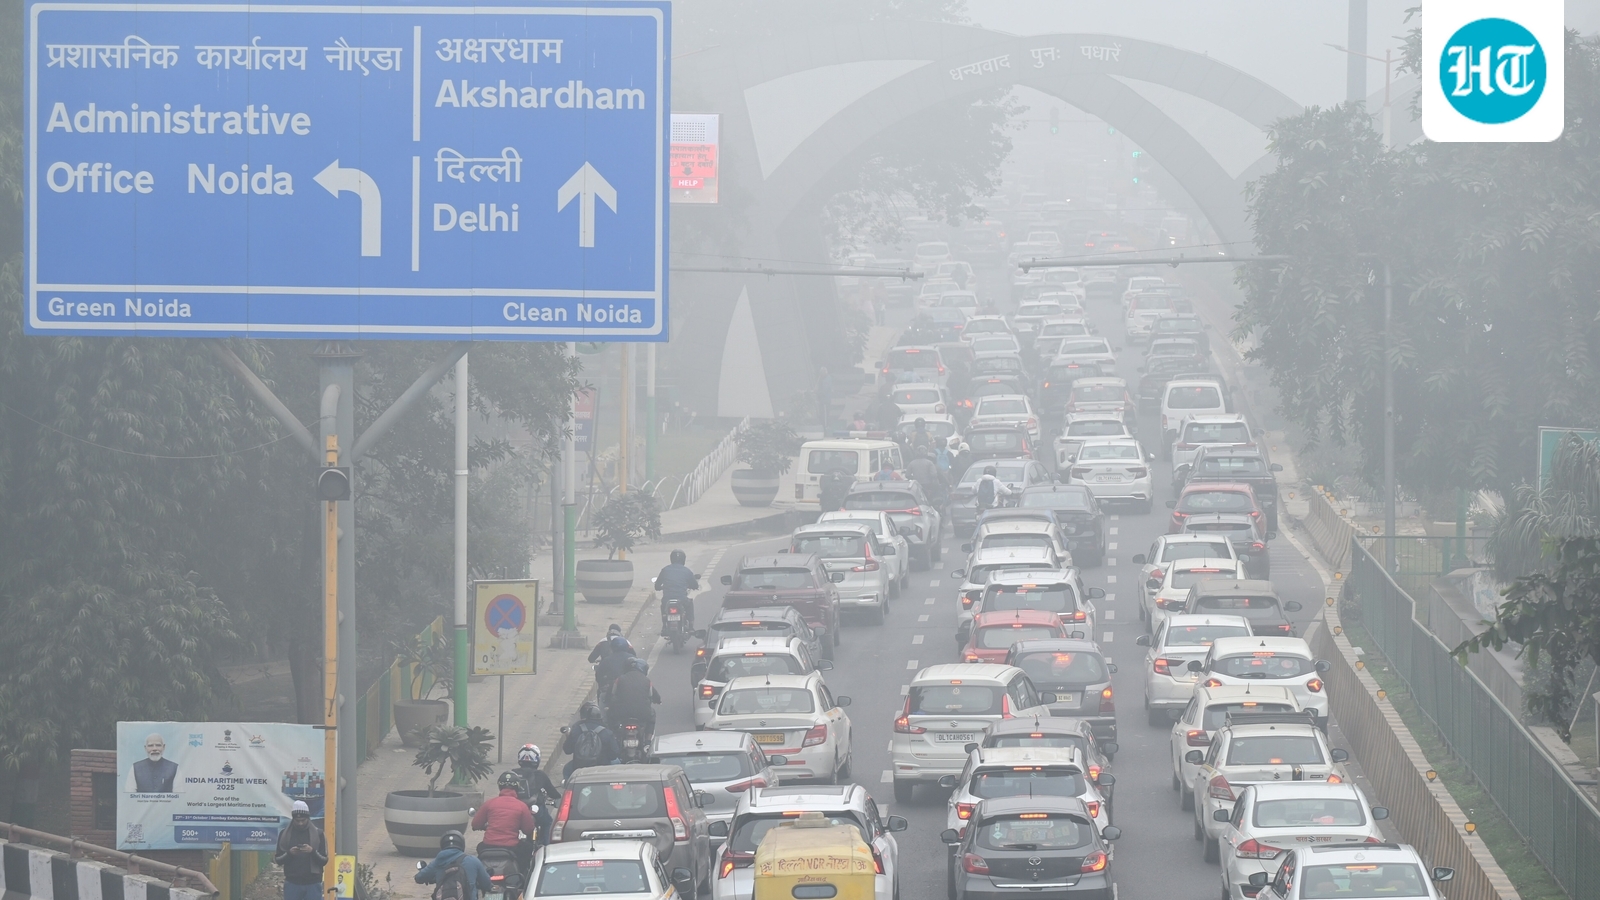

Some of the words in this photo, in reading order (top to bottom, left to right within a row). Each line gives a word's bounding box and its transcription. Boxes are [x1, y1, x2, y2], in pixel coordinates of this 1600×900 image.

[46, 35, 180, 69] प्रशासनिक
[195, 35, 308, 71] कार्यालय
[322, 36, 403, 76] नौएडा
[435, 36, 563, 64] अक्षरधाम
[949, 54, 1011, 81] धन्यवाद
[1030, 46, 1061, 69] पुनः
[1080, 42, 1122, 62] पधारें
[435, 80, 645, 110] Akshardham
[46, 103, 311, 136] Administrative
[46, 162, 154, 194] Office
[188, 164, 294, 195] Noida
[435, 147, 523, 183] दिल्ली
[433, 203, 519, 233] Delhi
[48, 298, 117, 319] Green
[124, 298, 192, 318] Noida
[502, 302, 567, 322] Clean
[575, 303, 642, 323] Noida
